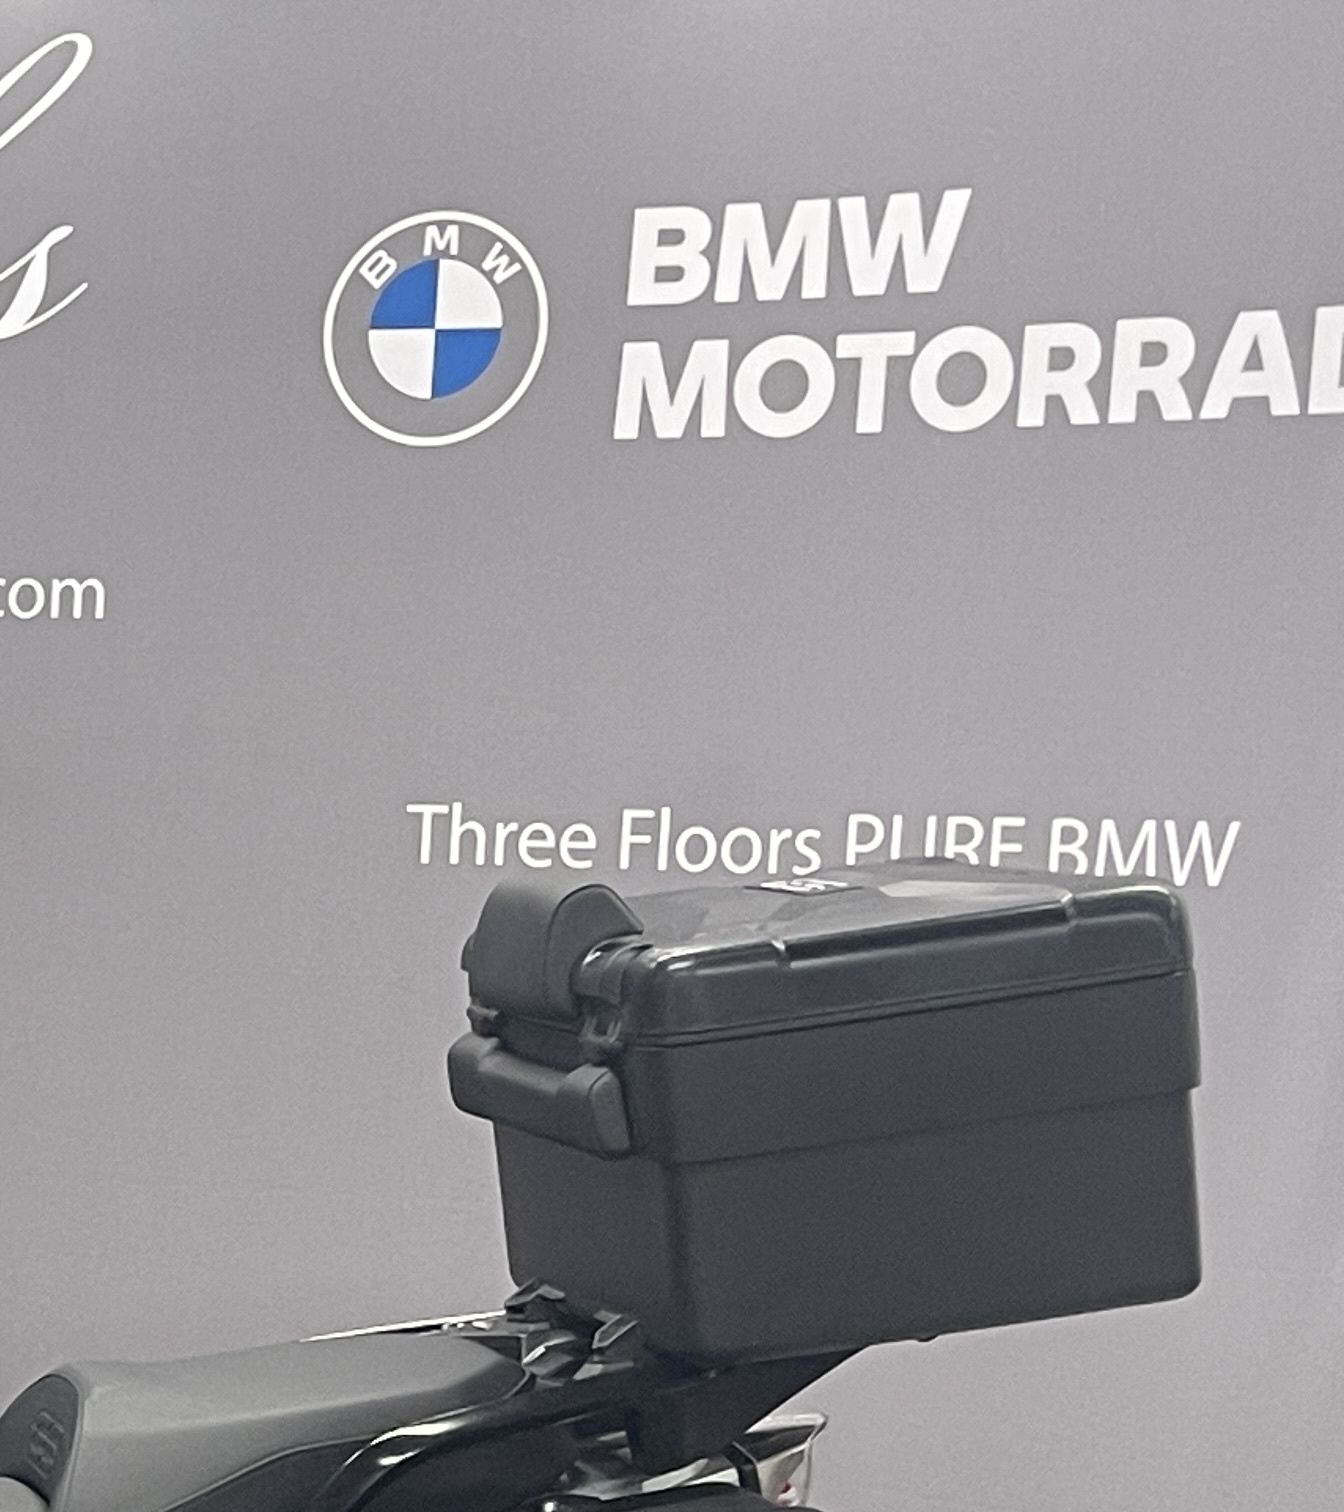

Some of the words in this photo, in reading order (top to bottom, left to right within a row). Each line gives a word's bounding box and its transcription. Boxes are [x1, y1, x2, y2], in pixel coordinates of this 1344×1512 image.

[358, 223, 522, 292] BMW
[626, 187, 973, 306] BMW
[406, 801, 598, 869] Three
[618, 806, 822, 876] Floors
[844, 812, 1026, 868] PURE
[1047, 816, 1241, 888] BMW
